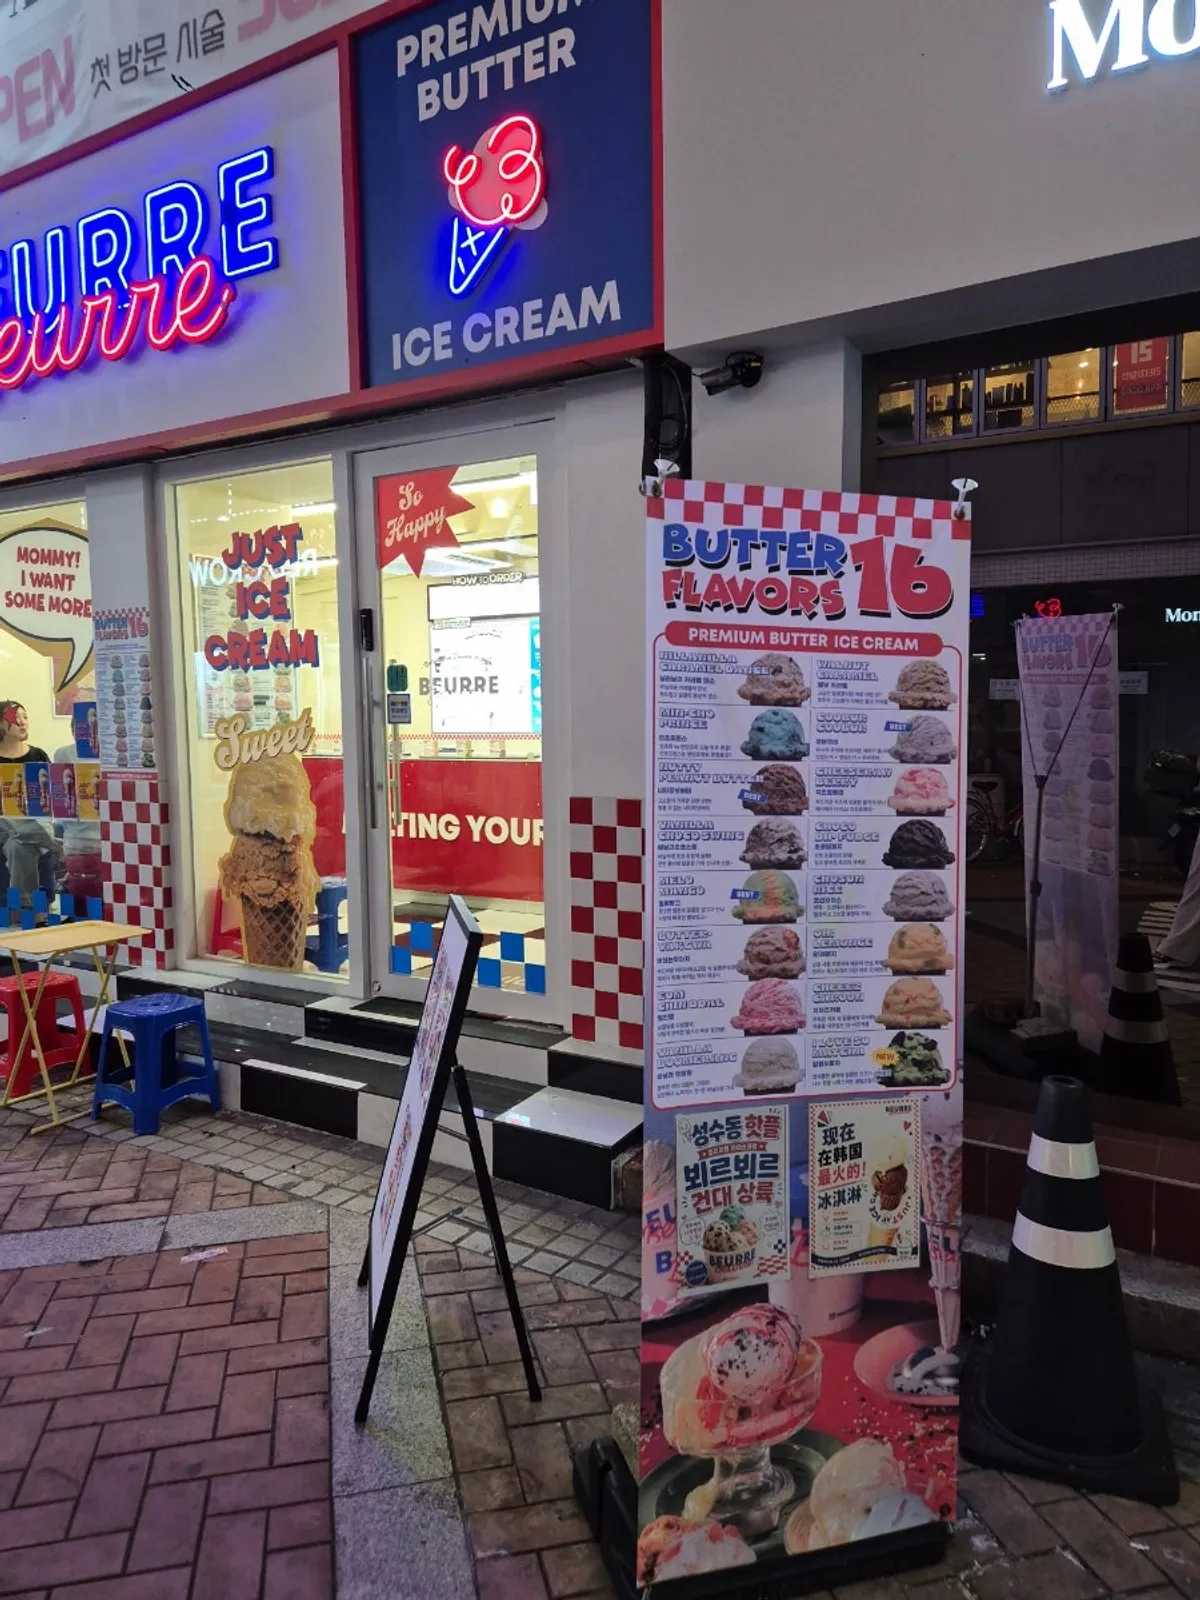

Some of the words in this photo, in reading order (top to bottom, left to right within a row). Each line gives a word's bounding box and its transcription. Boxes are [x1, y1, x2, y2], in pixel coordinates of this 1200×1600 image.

[91, 55, 111, 98] 첫
[118, 32, 168, 86] 방문
[177, 9, 226, 63] 시술
[418, 27, 576, 120] BUTTER
[392, 320, 453, 371] ICE
[462, 279, 622, 354] CREAM
[398, 481, 424, 511] So
[384, 506, 446, 547] Happy
[16, 546, 81, 568] MOMMY!
[222, 522, 304, 570] JUST
[20, 573, 26, 586] I
[30, 573, 76, 592] WANT
[452, 574, 478, 587] HOW
[489, 571, 523, 585] ORDER
[662, 523, 847, 578] BUTTER
[849, 534, 954, 619] 16
[4, 591, 45, 613] SOME
[236, 575, 292, 621] ICE
[661, 567, 847, 621] FLAVORS
[128, 616, 149, 639] 16
[688, 627, 765, 645] PREMIUM
[769, 631, 828, 648] BUTTER
[834, 632, 861, 648] ICE
[862, 633, 919, 651] CREAM
[204, 629, 320, 673] CREAM
[418, 675, 500, 696] BEURRE
[215, 708, 315, 770] Sweet
[692, 1115, 742, 1147] 성수동
[744, 1113, 780, 1139] 핫플
[822, 1122, 856, 1146] 现在
[818, 1142, 862, 1168] 在韩国
[683, 1153, 780, 1192] 뵈르뵈르
[691, 1185, 732, 1215] 건대
[736, 1181, 774, 1205] 상륙
[818, 1184, 863, 1210] 冰淇淋
[709, 1248, 756, 1267] BEURRE
